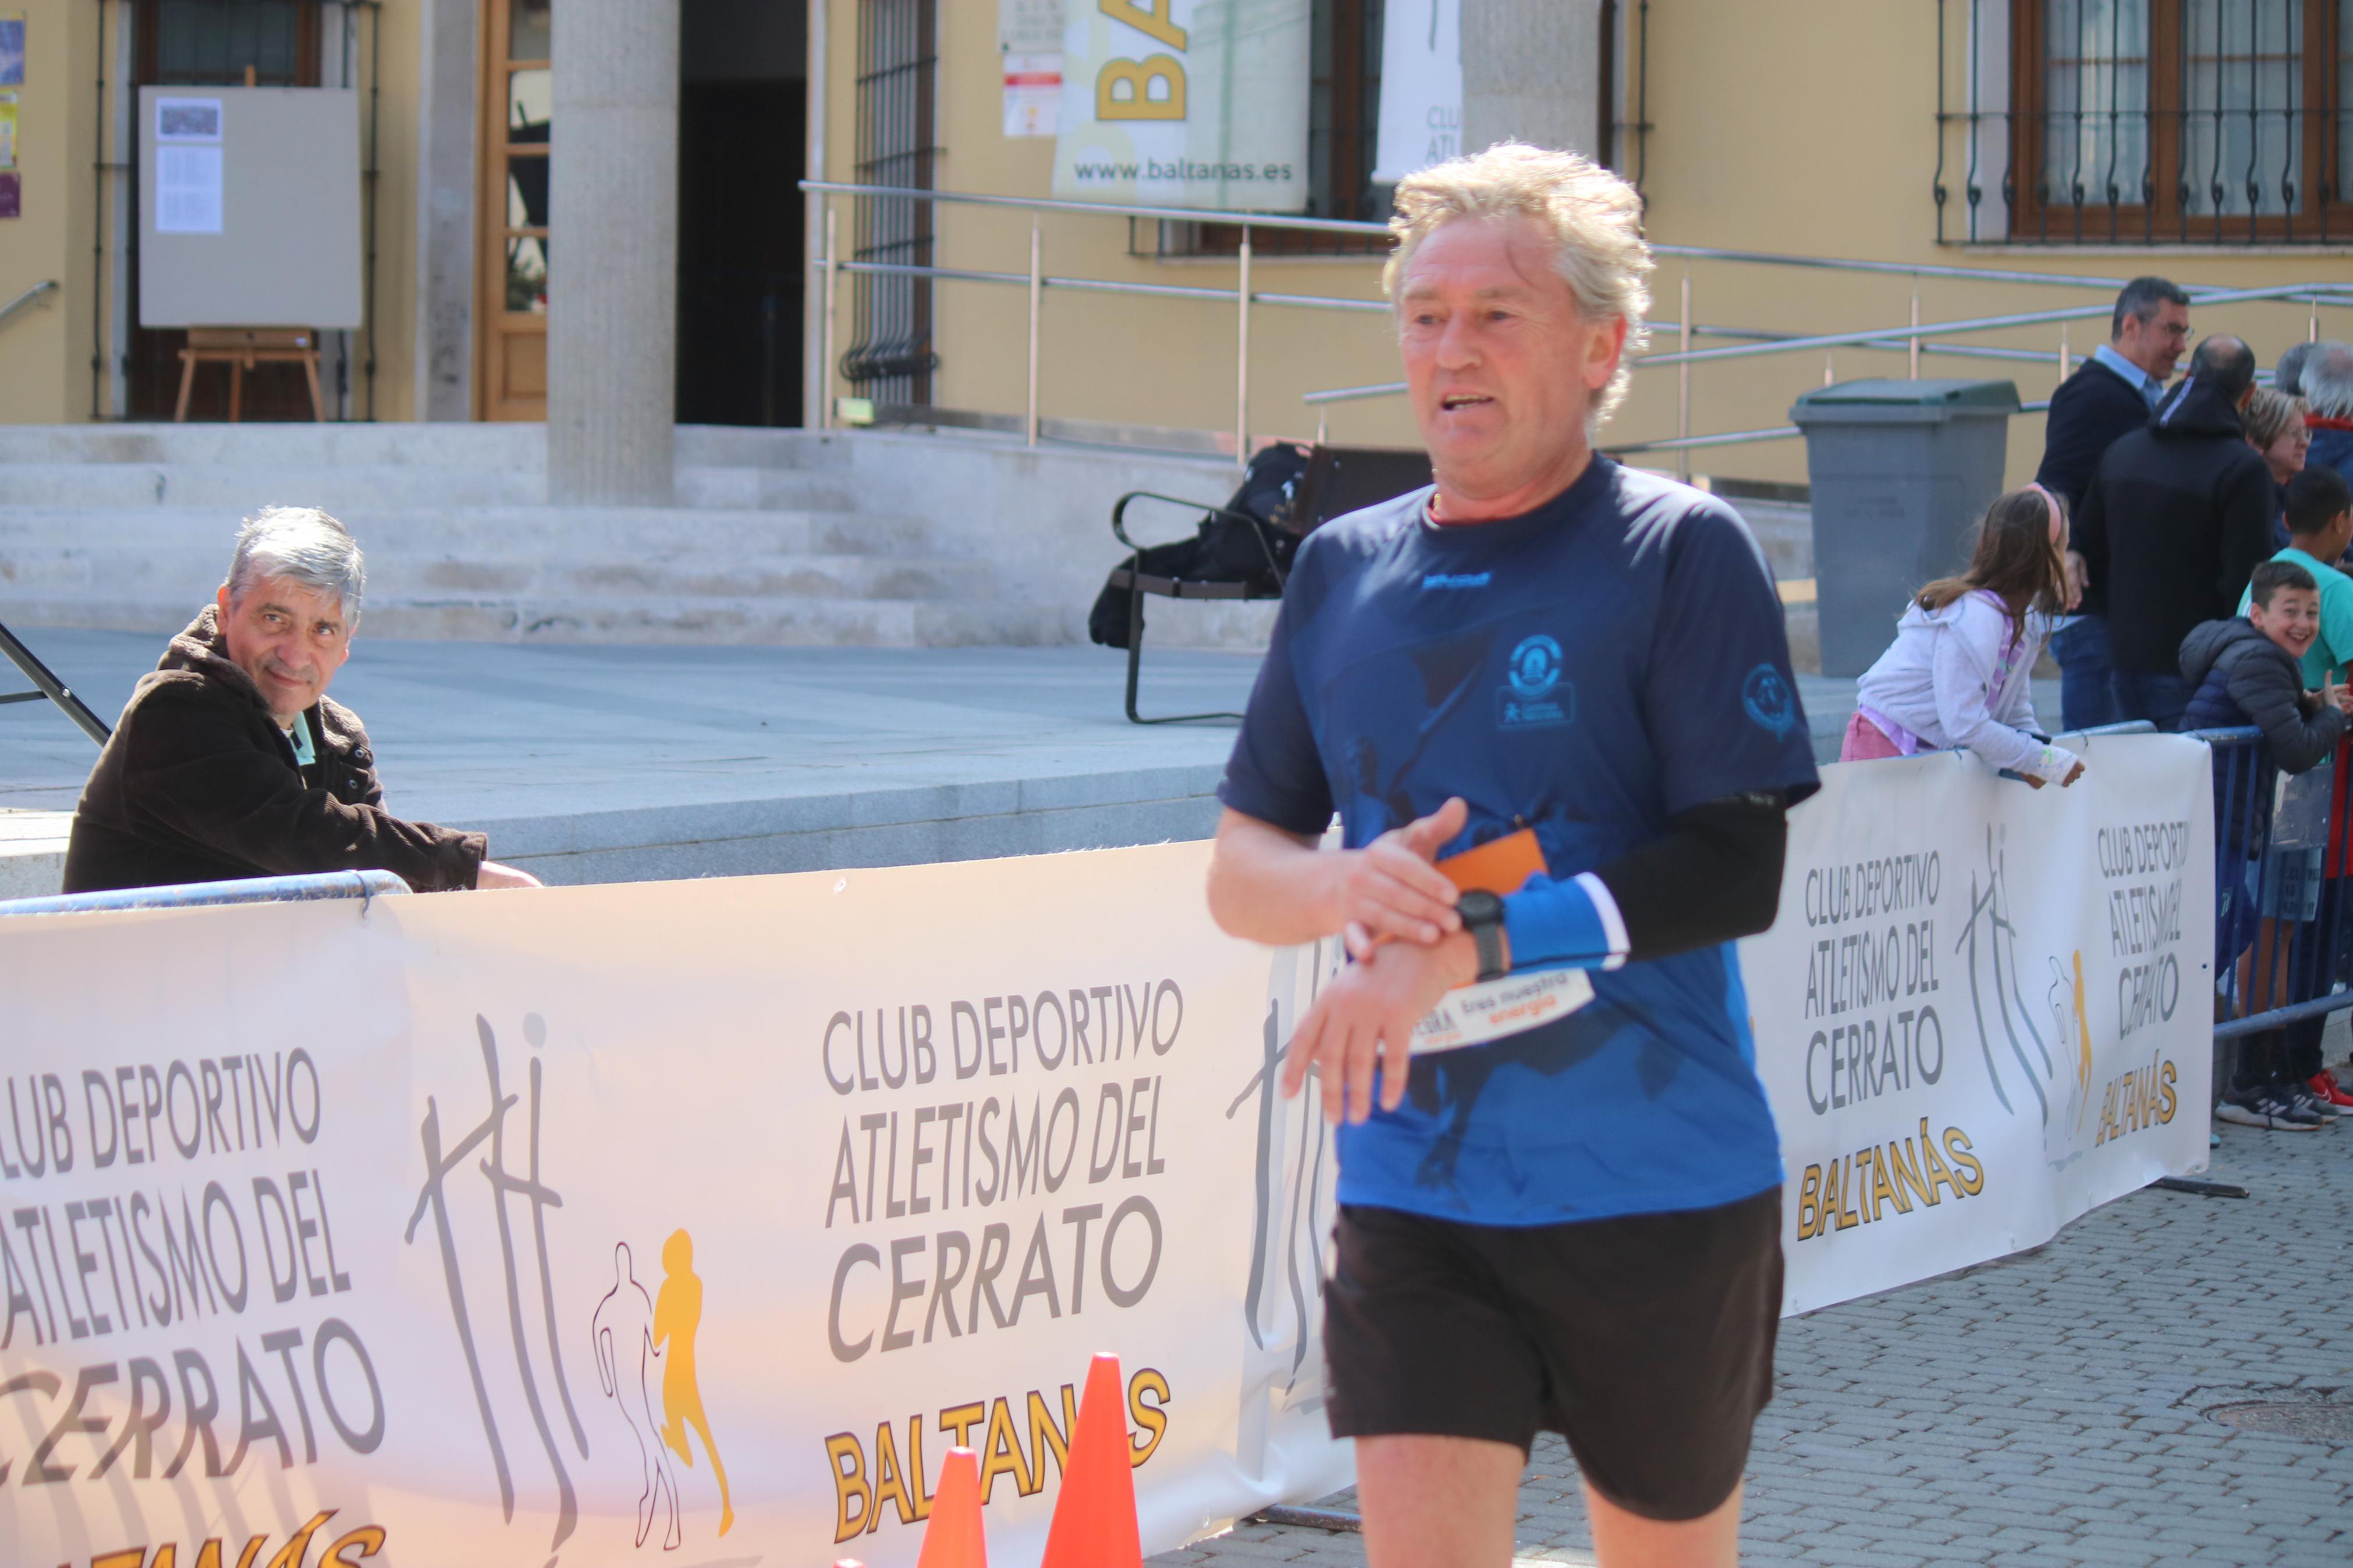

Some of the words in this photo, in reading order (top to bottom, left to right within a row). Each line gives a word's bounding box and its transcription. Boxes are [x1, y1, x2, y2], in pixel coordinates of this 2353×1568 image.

[1074, 157, 1293, 181] www.baltanas.es
[1805, 865, 1851, 927] CLUB
[1855, 849, 1940, 916] DEPORTIVO
[2098, 826, 2134, 879] CLUB
[2134, 820, 2192, 873] DEPORTI
[1805, 925, 1900, 1019] ATLETISMO
[1905, 919, 1939, 997] DEL
[823, 1002, 938, 1096] CLUB
[949, 978, 1184, 1081] DEPORTIVO
[1806, 1004, 1944, 1116] CERRATO
[81, 1047, 321, 1169] DEPORTIVO
[824, 1086, 1081, 1229] ATLETISMO
[1088, 1075, 1166, 1185] DEL
[2095, 1048, 2177, 1148] BALTANÁS
[1797, 1117, 1984, 1242] BALTANÁS
[0, 1180, 249, 1351] ATLETISMO
[251, 1168, 352, 1304] DEL
[826, 1194, 1163, 1364] CERRATO
[824, 1367, 1172, 1544] BALTANS
